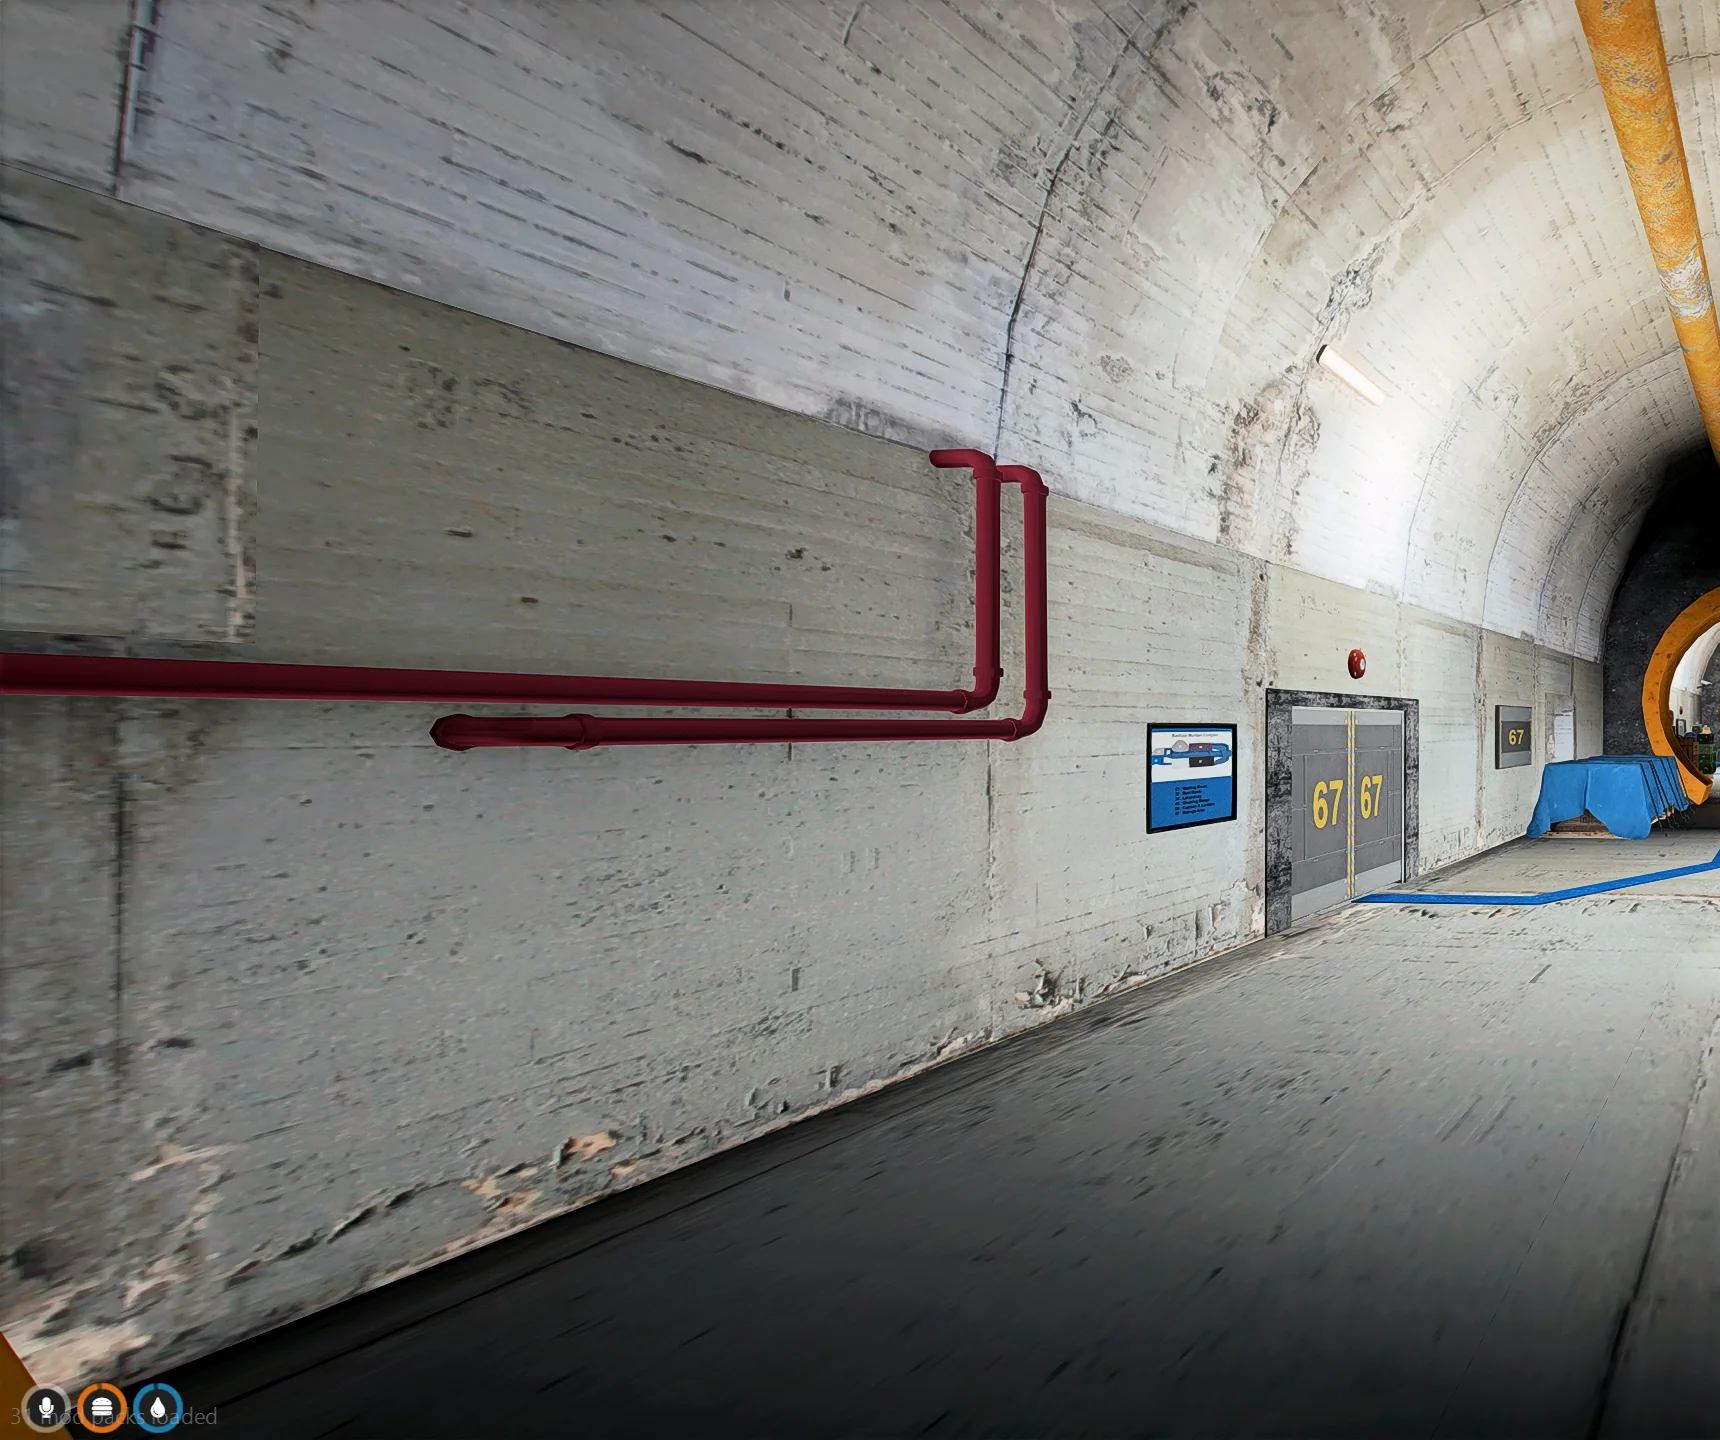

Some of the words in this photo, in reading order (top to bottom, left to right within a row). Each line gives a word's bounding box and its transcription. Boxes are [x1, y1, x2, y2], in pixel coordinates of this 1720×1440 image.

[1508, 729, 1525, 745] 67
[1312, 779, 1344, 829] 67
[1360, 774, 1383, 820] 67
